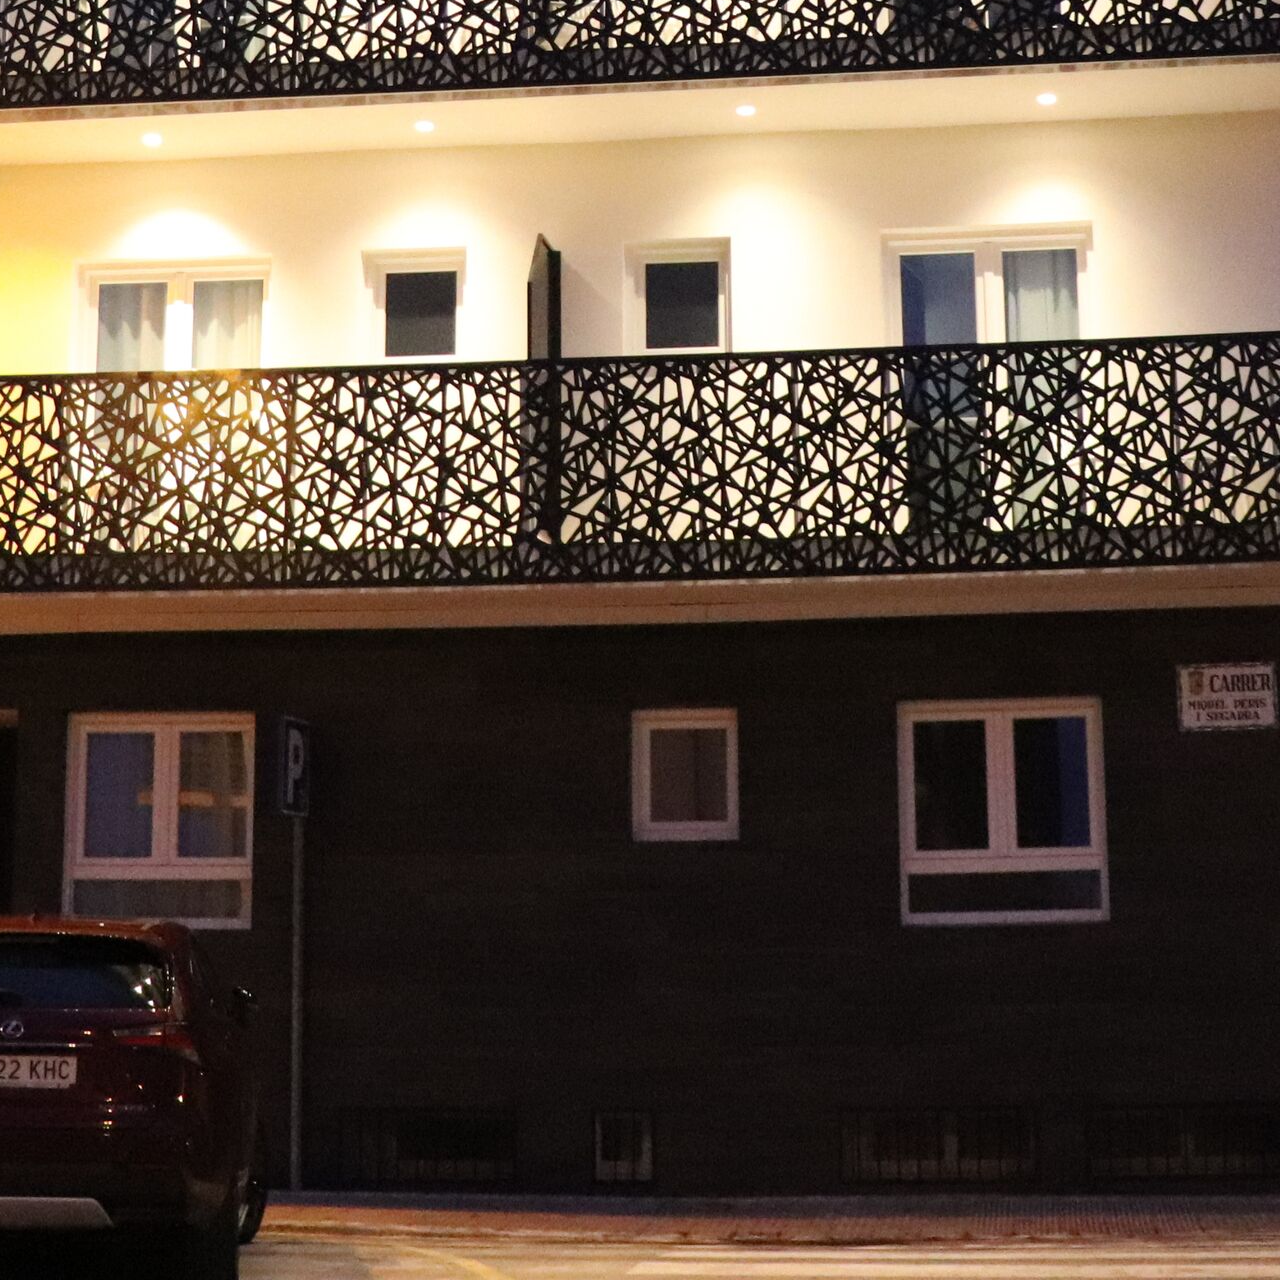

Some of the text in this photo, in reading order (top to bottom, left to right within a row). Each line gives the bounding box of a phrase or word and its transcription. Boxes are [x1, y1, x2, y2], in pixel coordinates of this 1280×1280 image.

[1210, 674, 1271, 693] CARRER
[1188, 699, 1227, 711] MIQUEL
[287, 729, 304, 804] P
[29, 1059, 70, 1080] KHC
